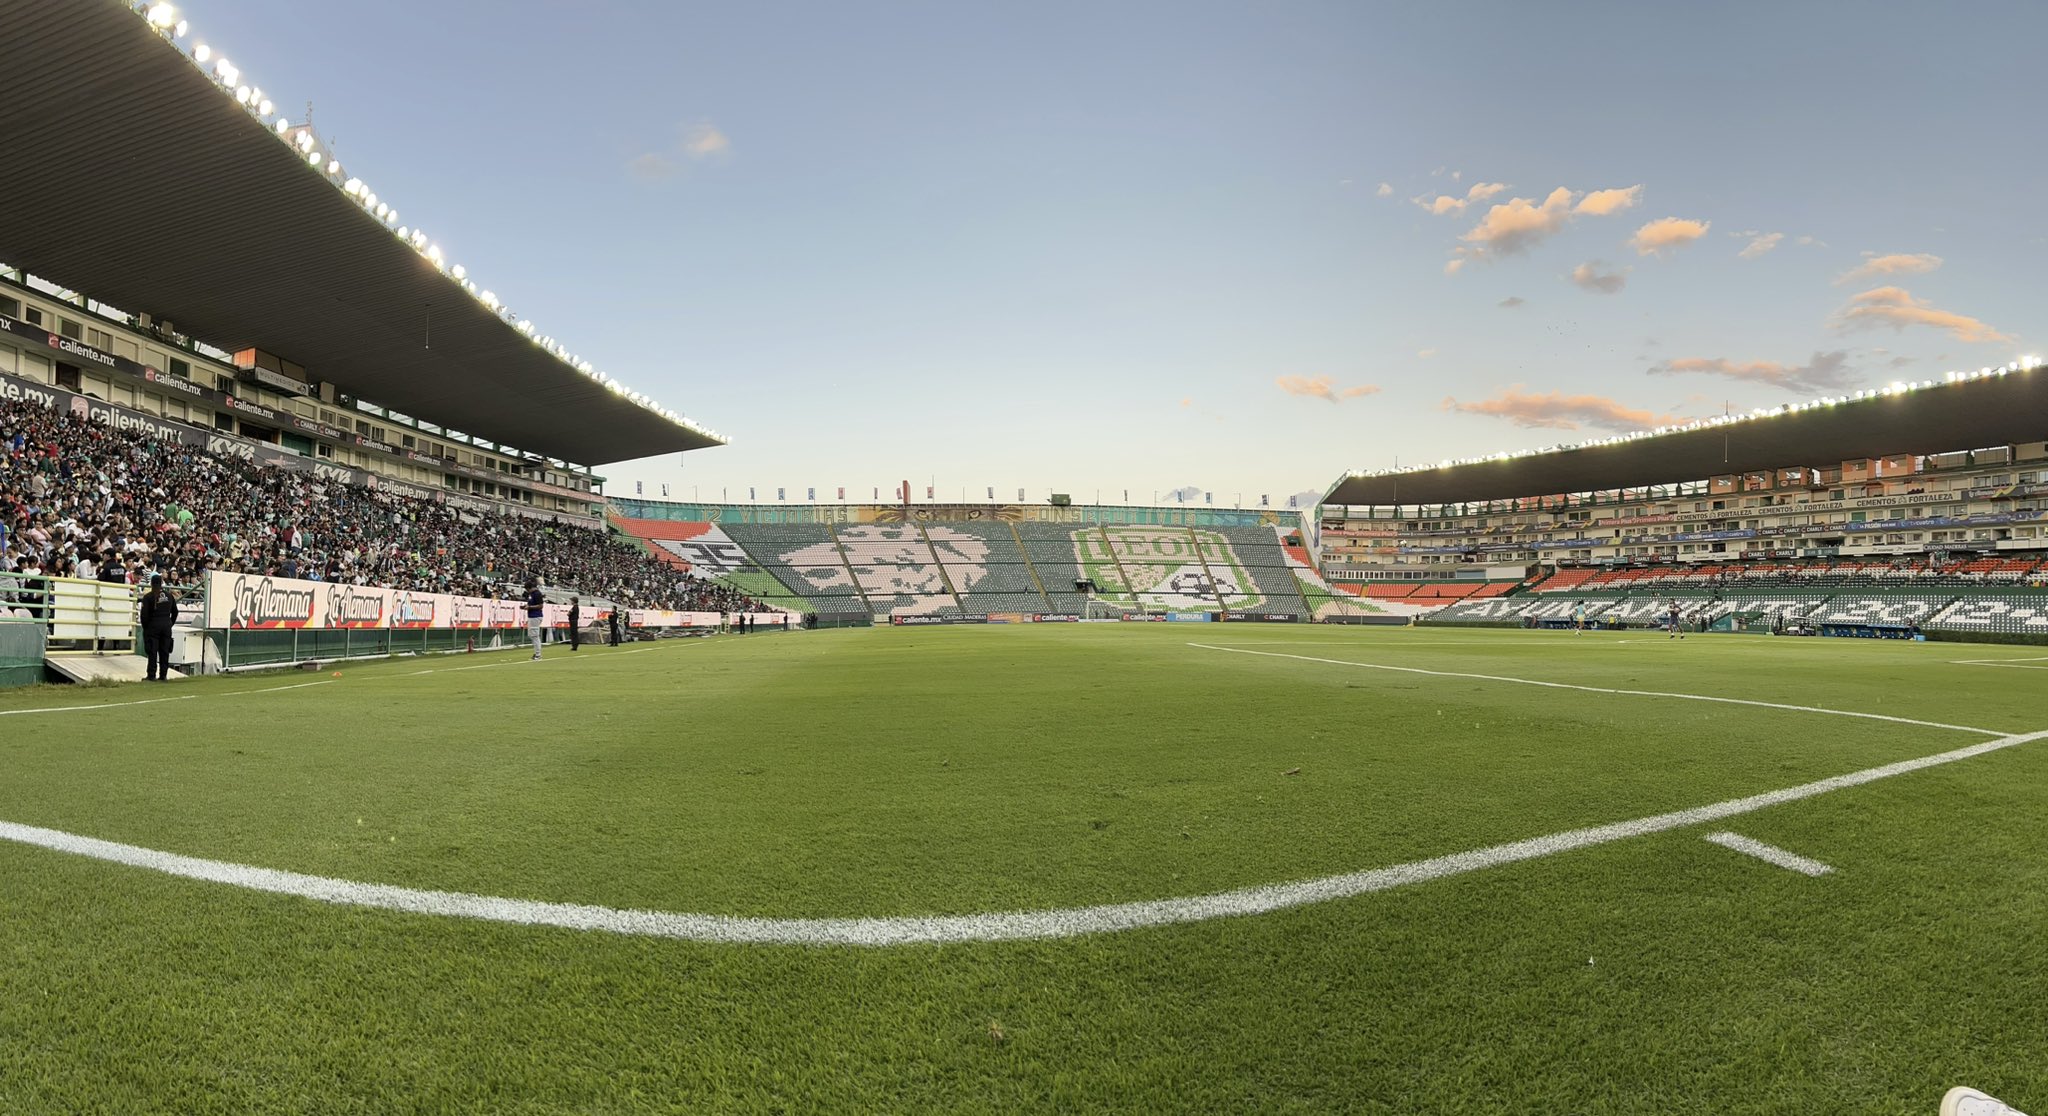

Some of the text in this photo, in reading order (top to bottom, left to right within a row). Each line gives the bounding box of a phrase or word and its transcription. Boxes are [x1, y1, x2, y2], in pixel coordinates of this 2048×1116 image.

[60, 340, 115, 367] caliente.mx
[155, 373, 201, 396] caliente.mx
[234, 399, 274, 419] caliente.mx
[300, 420, 340, 437] CHARLY CHARLY
[362, 440, 393, 454] caliente.mx
[413, 453, 441, 466] caliente.mx
[378, 480, 430, 500] caliente.mx
[1758, 502, 1843, 514] CEMENTOS FORTALEZA
[1857, 493, 1953, 507] CEMENTOS FORTALEZA
[740, 507, 848, 524] VICTORIAS
[1717, 510, 1752, 518] FORTALEZA
[234, 576, 311, 628] La Alemana
[328, 585, 380, 627] La Alemana
[902, 616, 942, 624] caliente.mx
